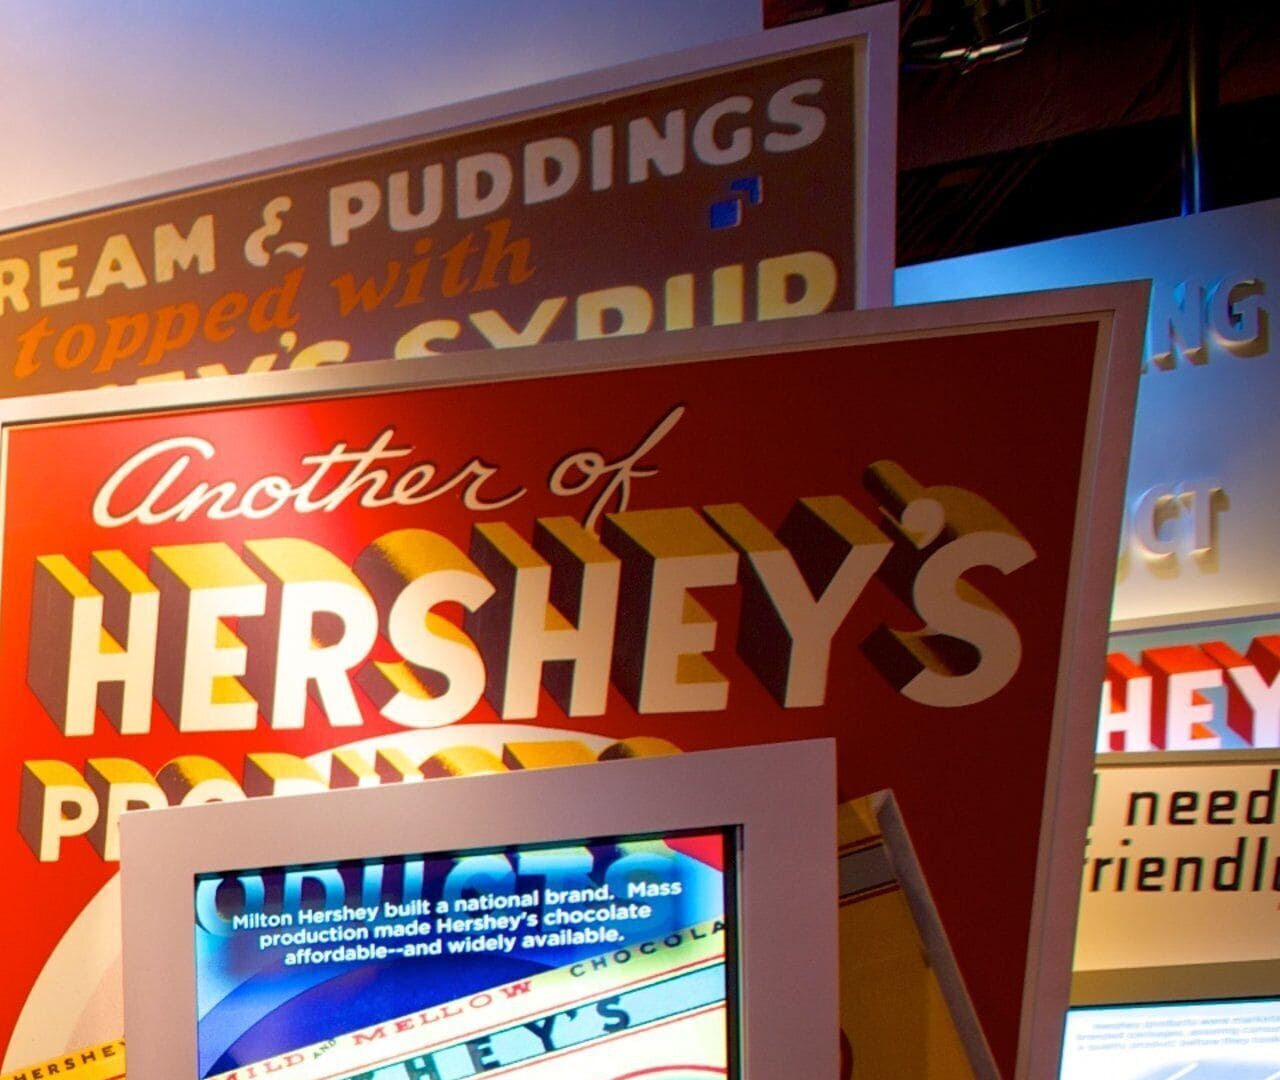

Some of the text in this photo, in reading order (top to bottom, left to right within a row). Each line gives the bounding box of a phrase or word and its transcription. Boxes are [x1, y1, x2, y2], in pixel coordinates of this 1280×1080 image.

[244, 195, 308, 268] &
[328, 77, 826, 247] PUDDINGS
[13, 267, 301, 380] topped
[329, 217, 536, 318] with
[1142, 277, 1269, 372] NG
[90, 405, 685, 531] Another of
[1130, 483, 1229, 582] CT
[30, 475, 1039, 738] HERSHEY'S
[232, 879, 682, 931] Milton Hershey built a national brand. Mass
[1085, 837, 1280, 892] riendl
[259, 901, 652, 949] production made Hershey's chocolate
[447, 931, 517, 957] widely
[522, 925, 625, 950] available.
[311, 1038, 338, 1061] AND
[351, 980, 533, 1048] MELLOW
